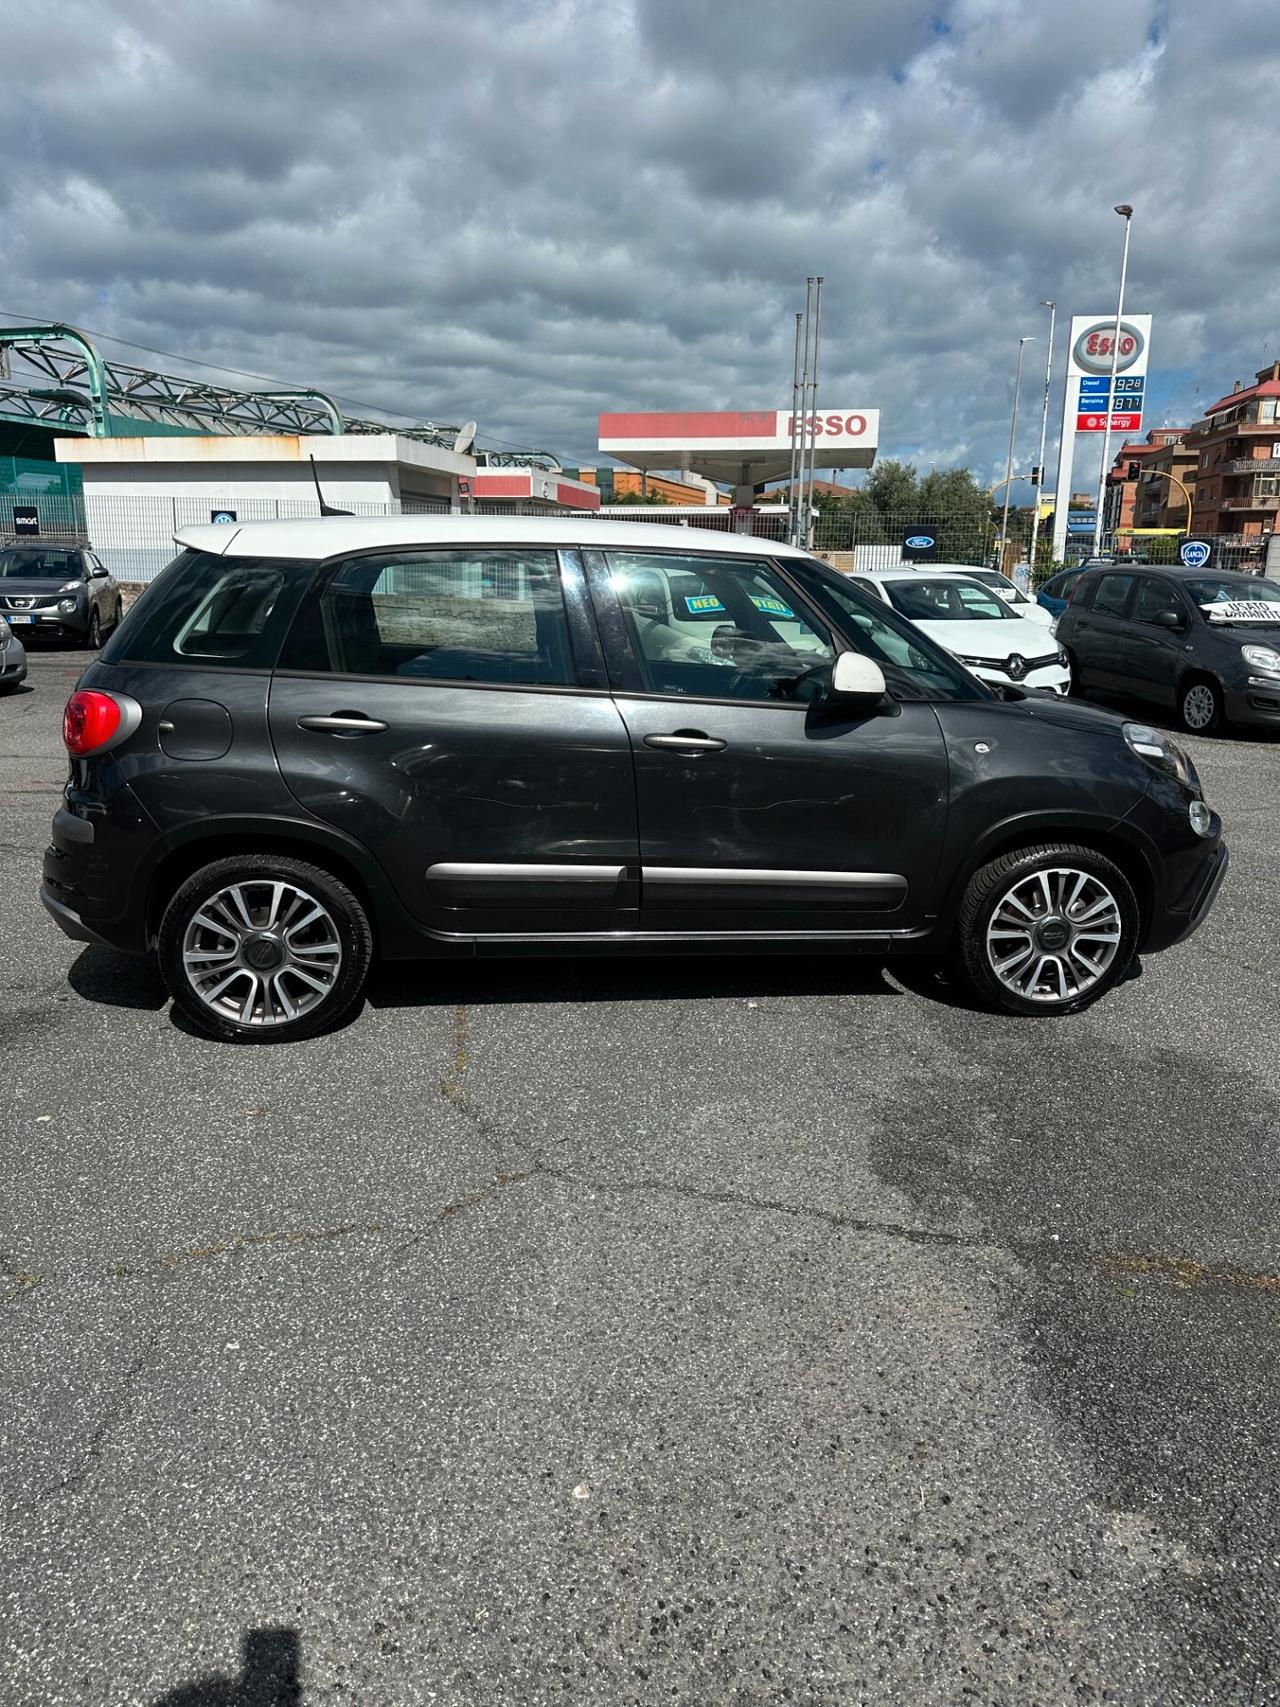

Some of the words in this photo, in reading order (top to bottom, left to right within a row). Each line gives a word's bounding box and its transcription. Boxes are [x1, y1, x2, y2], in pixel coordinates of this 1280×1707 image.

[788, 414, 867, 437] ESSO
[15, 517, 38, 525] smart
[1228, 602, 1270, 612] USATO
